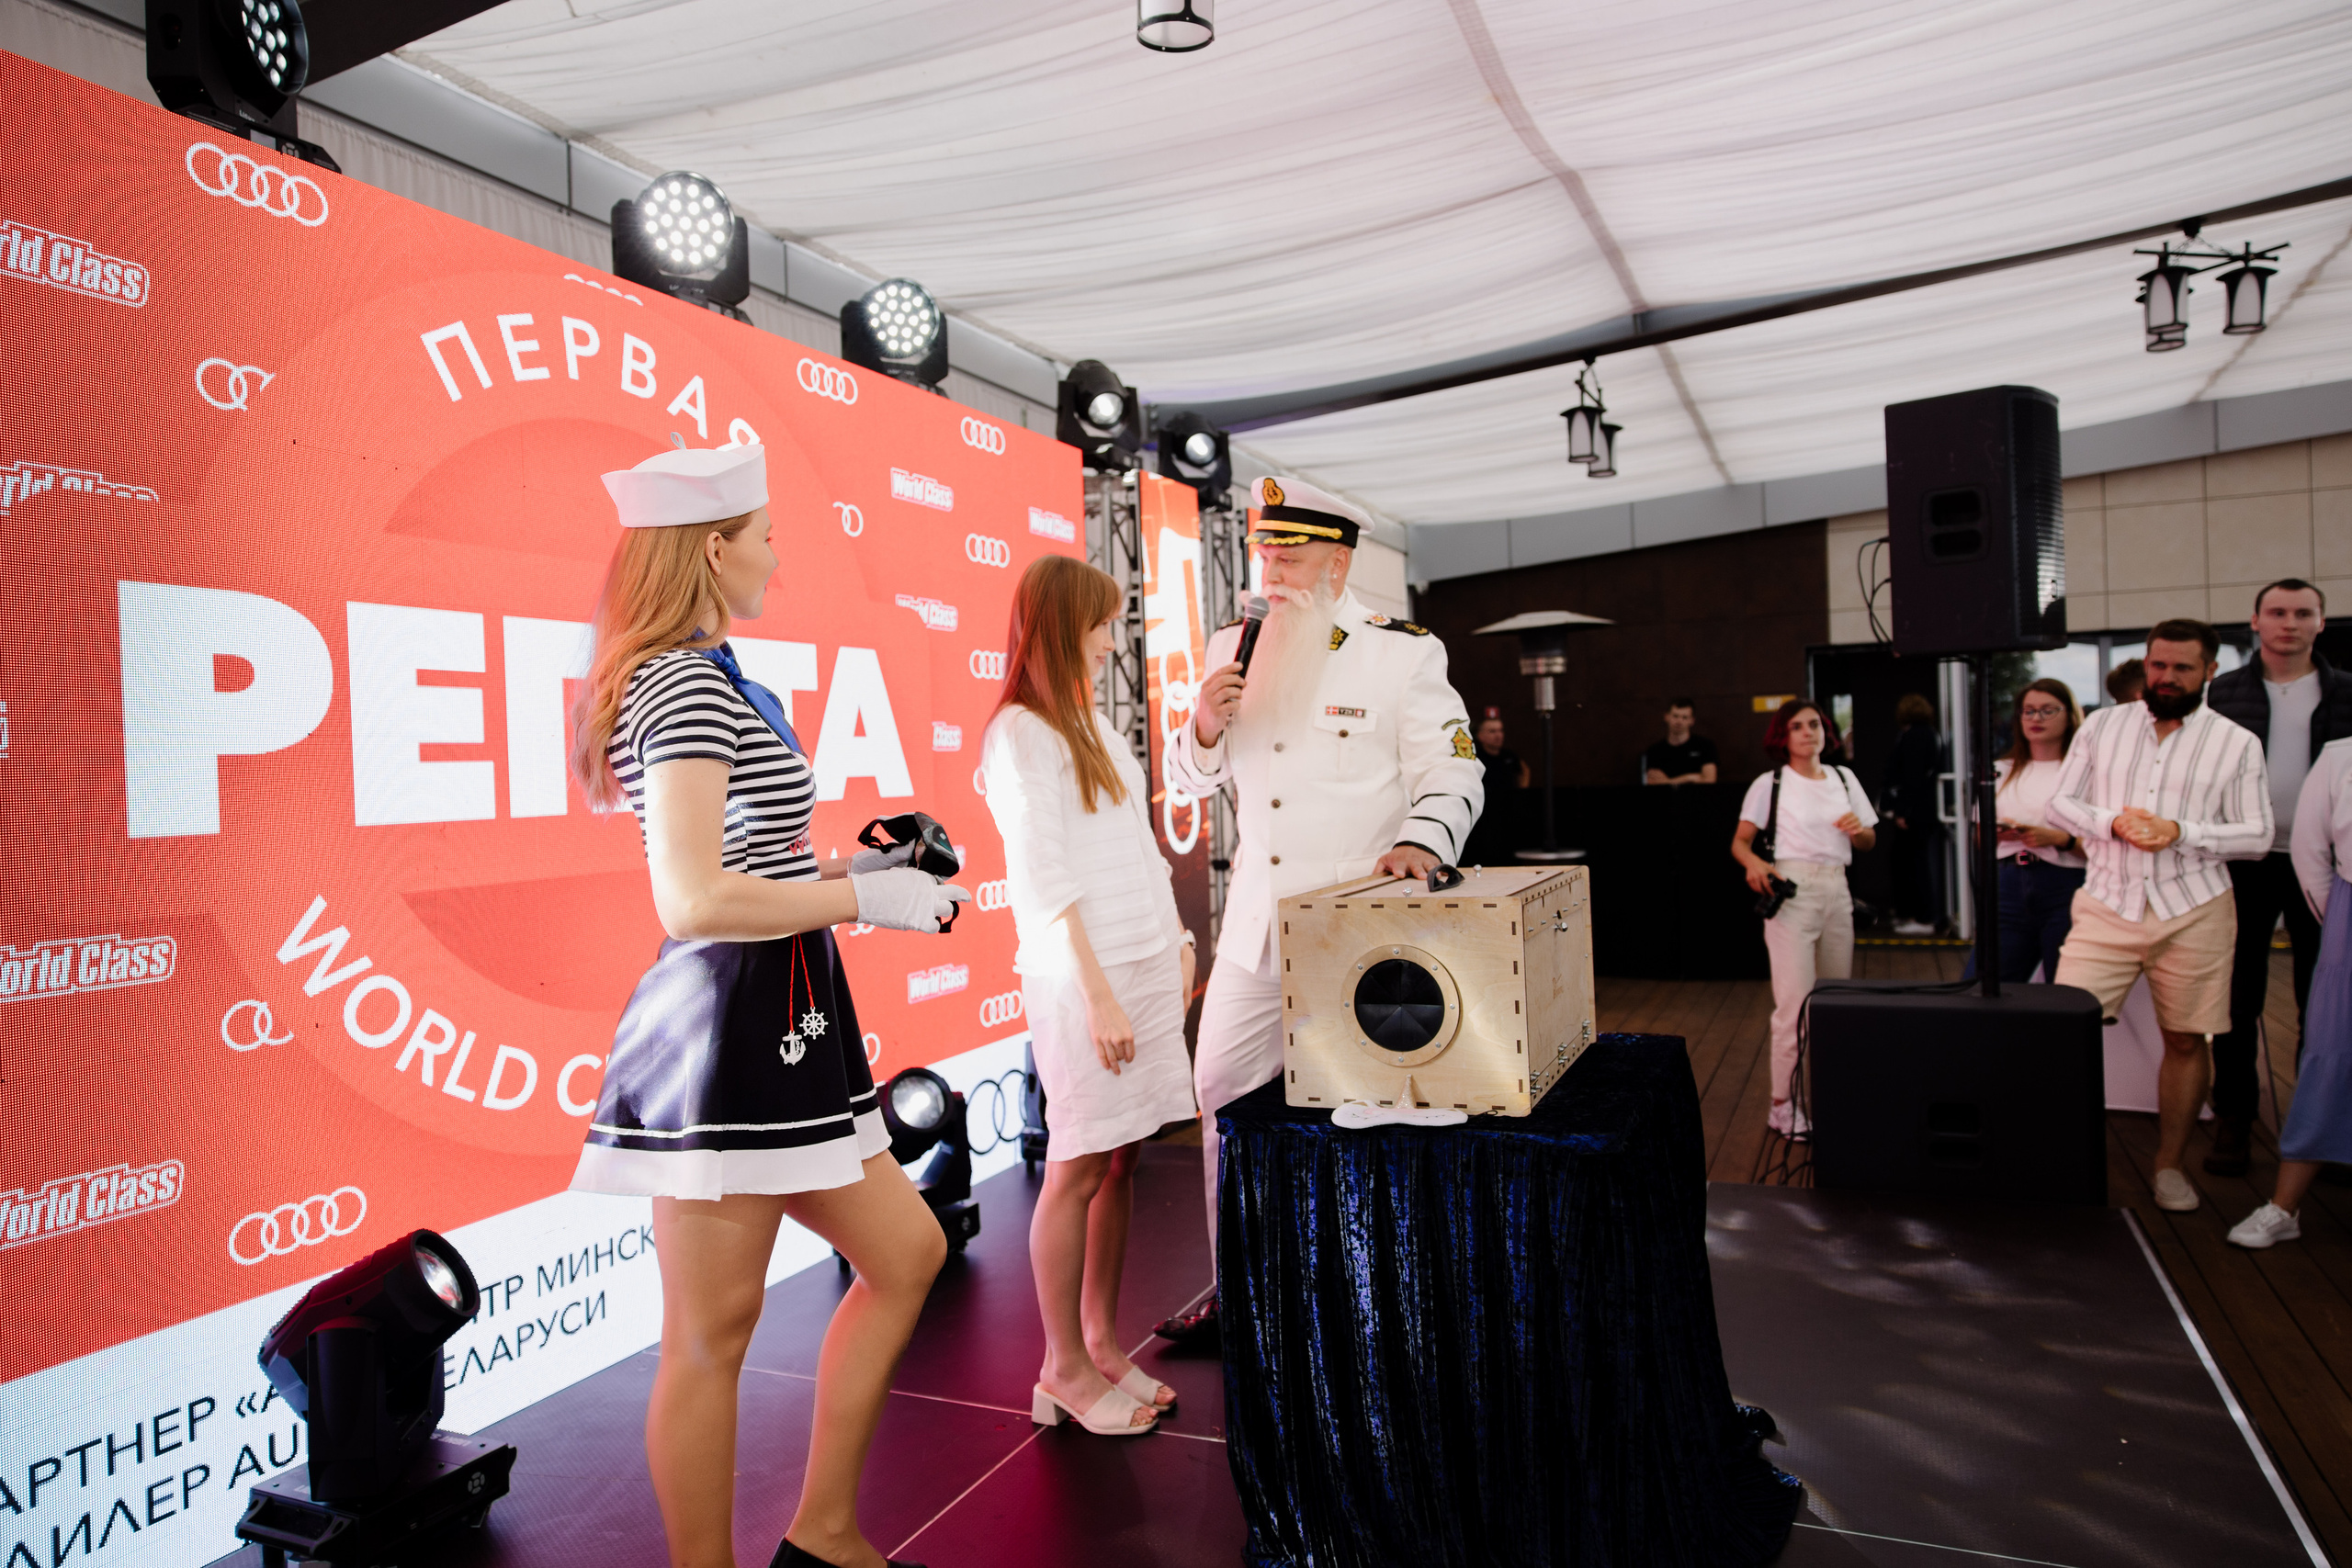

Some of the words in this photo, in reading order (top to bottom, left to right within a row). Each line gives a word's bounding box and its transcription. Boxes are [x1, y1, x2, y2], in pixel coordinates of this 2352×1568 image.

[50, 241, 143, 300] Class
[0, 946, 73, 995] orld
[78, 942, 171, 985] Class
[276, 893, 538, 1111] WORLD
[85, 1166, 177, 1220] Class
[0, 1395, 216, 1516] АРТНЕР
